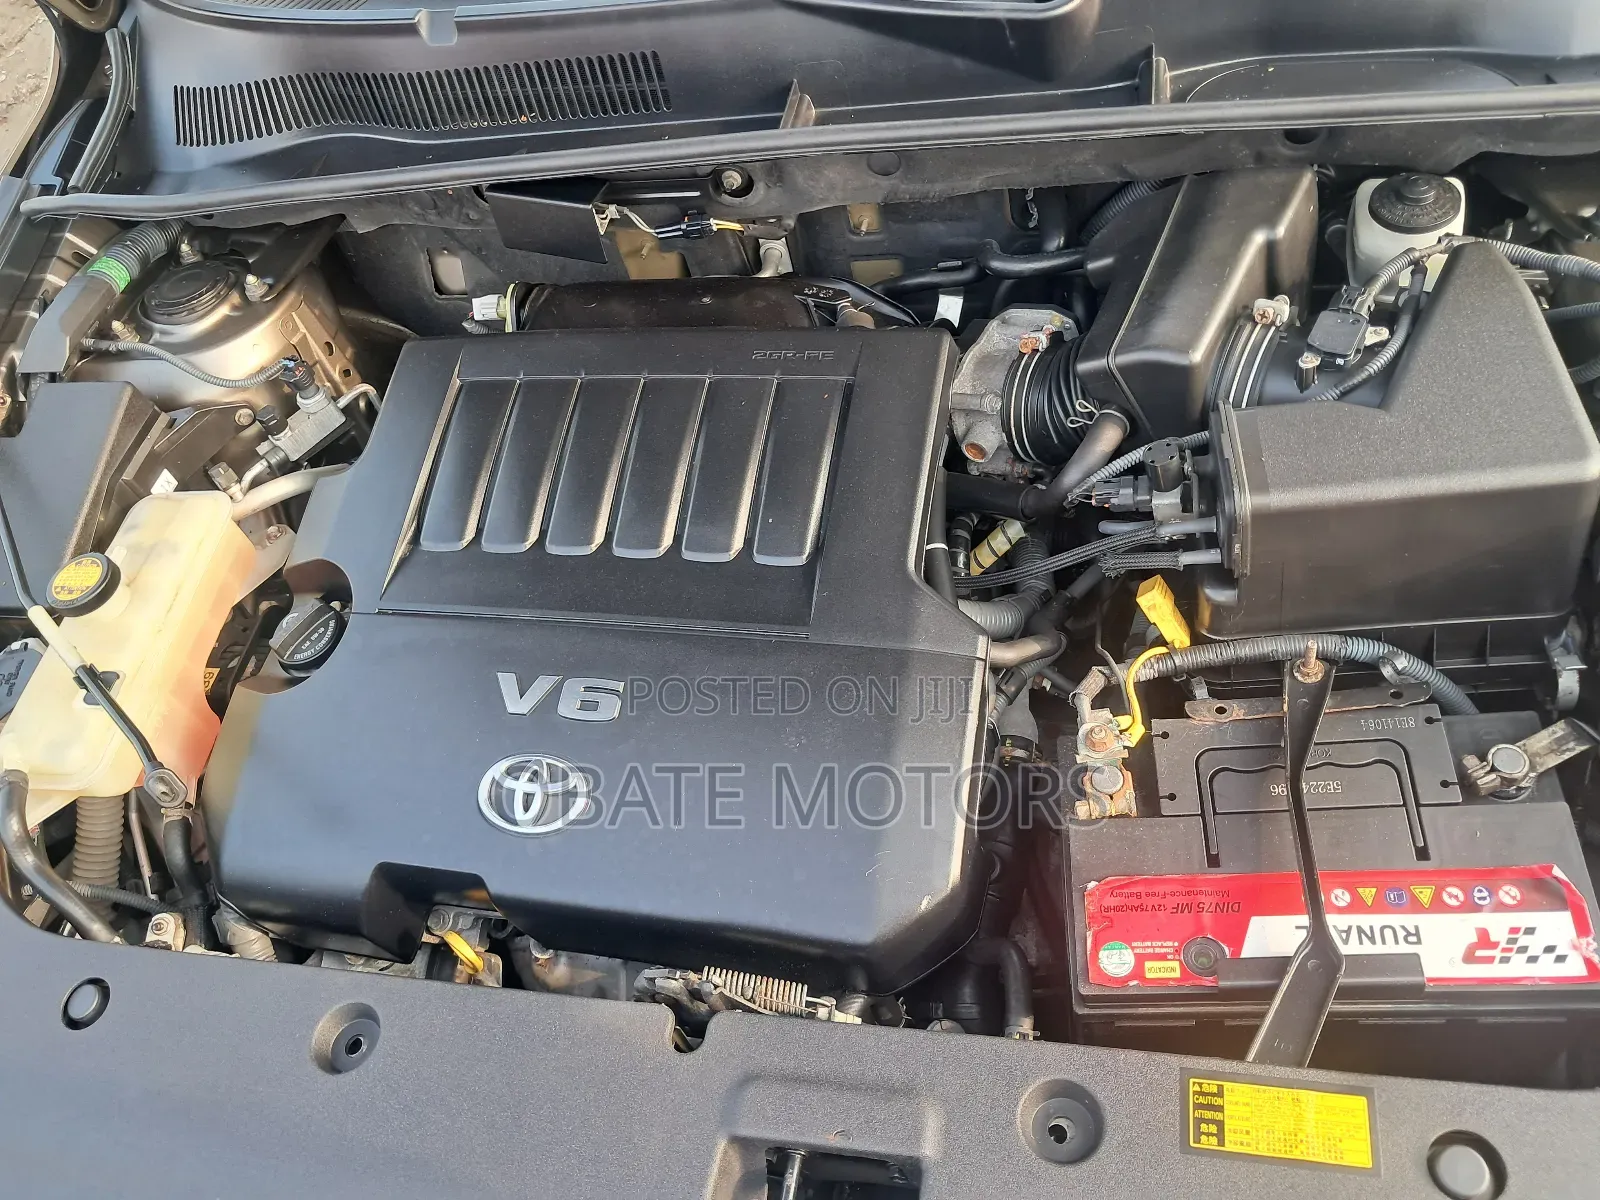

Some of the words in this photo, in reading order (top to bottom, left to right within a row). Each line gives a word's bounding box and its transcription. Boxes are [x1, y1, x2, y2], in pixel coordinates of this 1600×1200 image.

[751, 349, 835, 361] 2GR-FE
[293, 647, 316, 660] ENERGY
[496, 671, 626, 723] V6
[1109, 889, 1142, 899] Battery
[1144, 889, 1230, 899] Maintenance-Free
[1170, 902, 1194, 914] MF
[1197, 901, 1241, 914] DIN75
[1294, 924, 1423, 946] RUNAL
[1147, 965, 1177, 974] INDICATOR
[1193, 1094, 1224, 1106] CAUTION
[1194, 1109, 1224, 1121] ATTENTION
